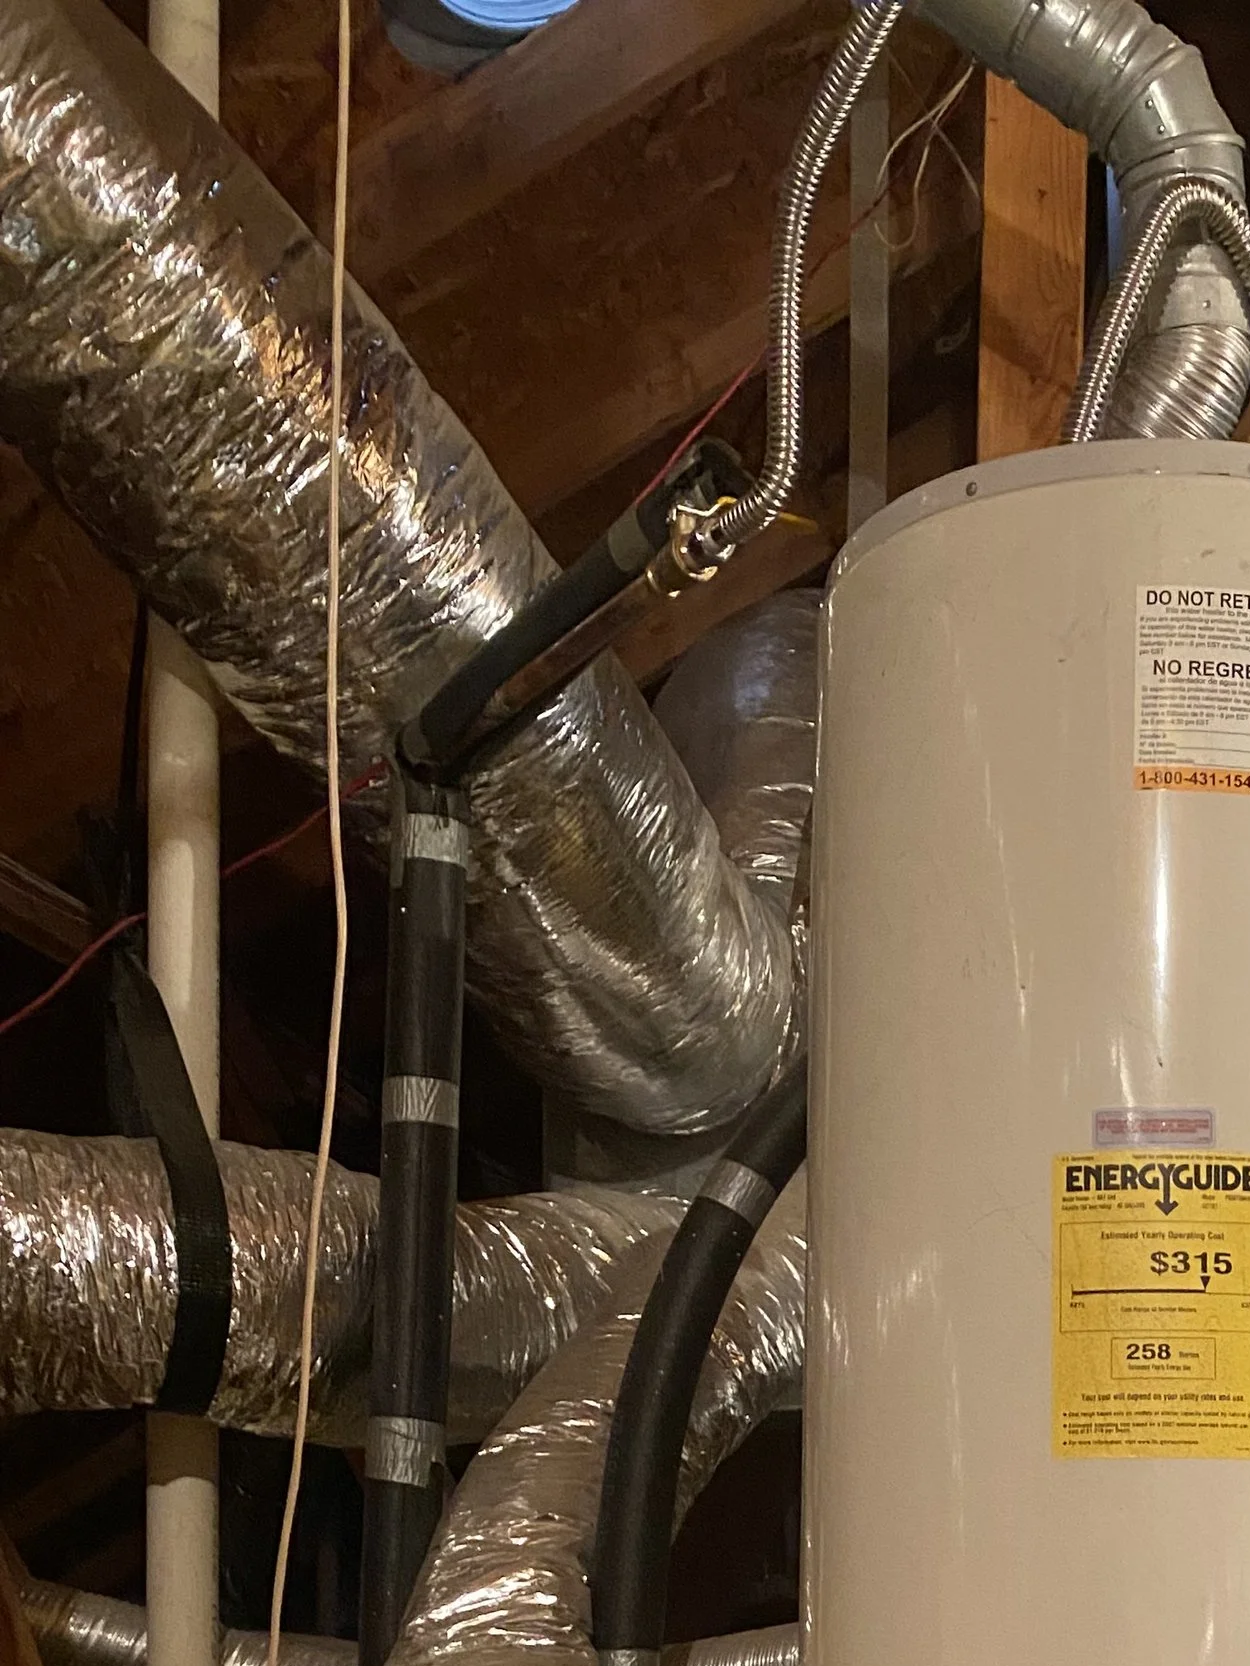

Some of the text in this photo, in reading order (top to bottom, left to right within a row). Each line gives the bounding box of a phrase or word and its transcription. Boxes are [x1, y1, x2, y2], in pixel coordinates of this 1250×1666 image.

[1147, 591, 1171, 605] DO
[1179, 591, 1214, 606] NOT
[1154, 660, 1181, 675] NO
[1101, 1232, 1138, 1241] Estimated
[1141, 1232, 1165, 1241] Yearly
[1207, 1232, 1224, 1240] Cost
[1150, 1251, 1233, 1276] $315
[1126, 1344, 1171, 1360] 258
